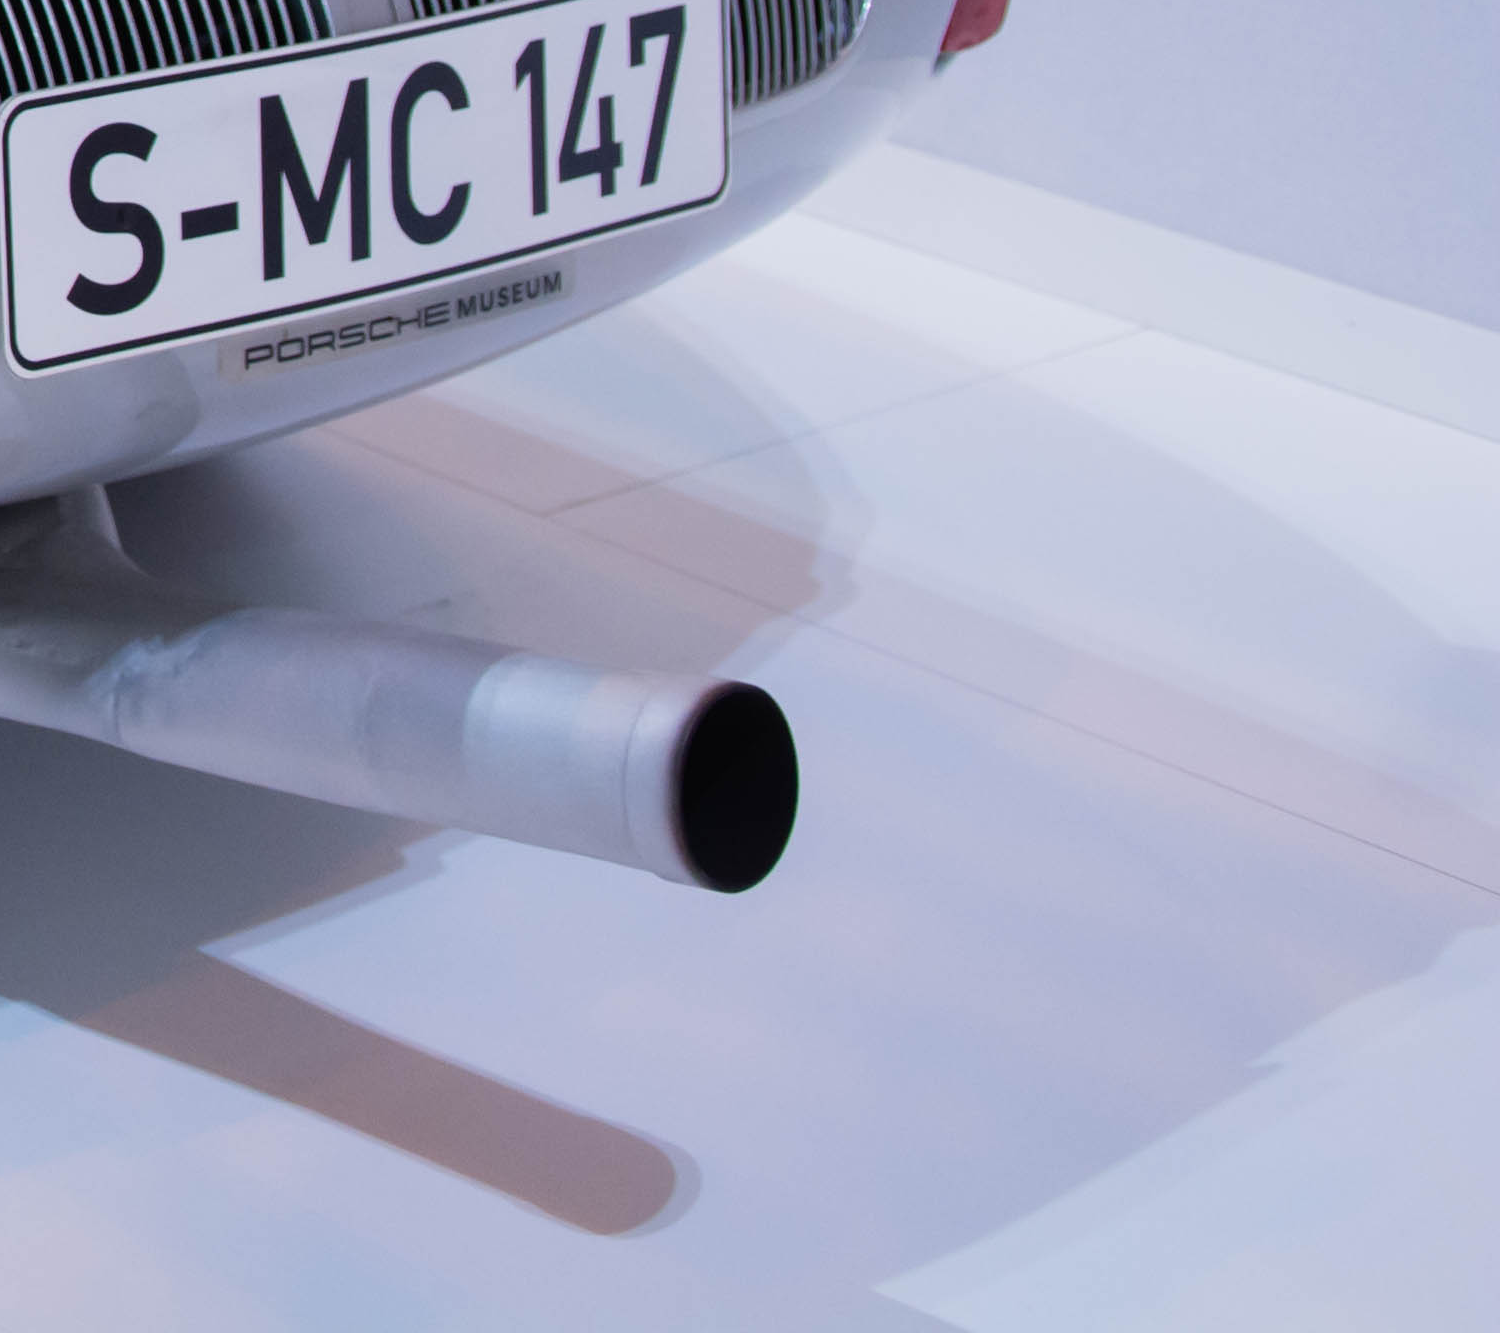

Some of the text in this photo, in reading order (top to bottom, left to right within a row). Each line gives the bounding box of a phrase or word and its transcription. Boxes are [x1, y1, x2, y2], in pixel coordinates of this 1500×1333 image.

[66, 4, 688, 316] S-MC 147
[244, 270, 563, 371] PORSCHE MUSEUM
